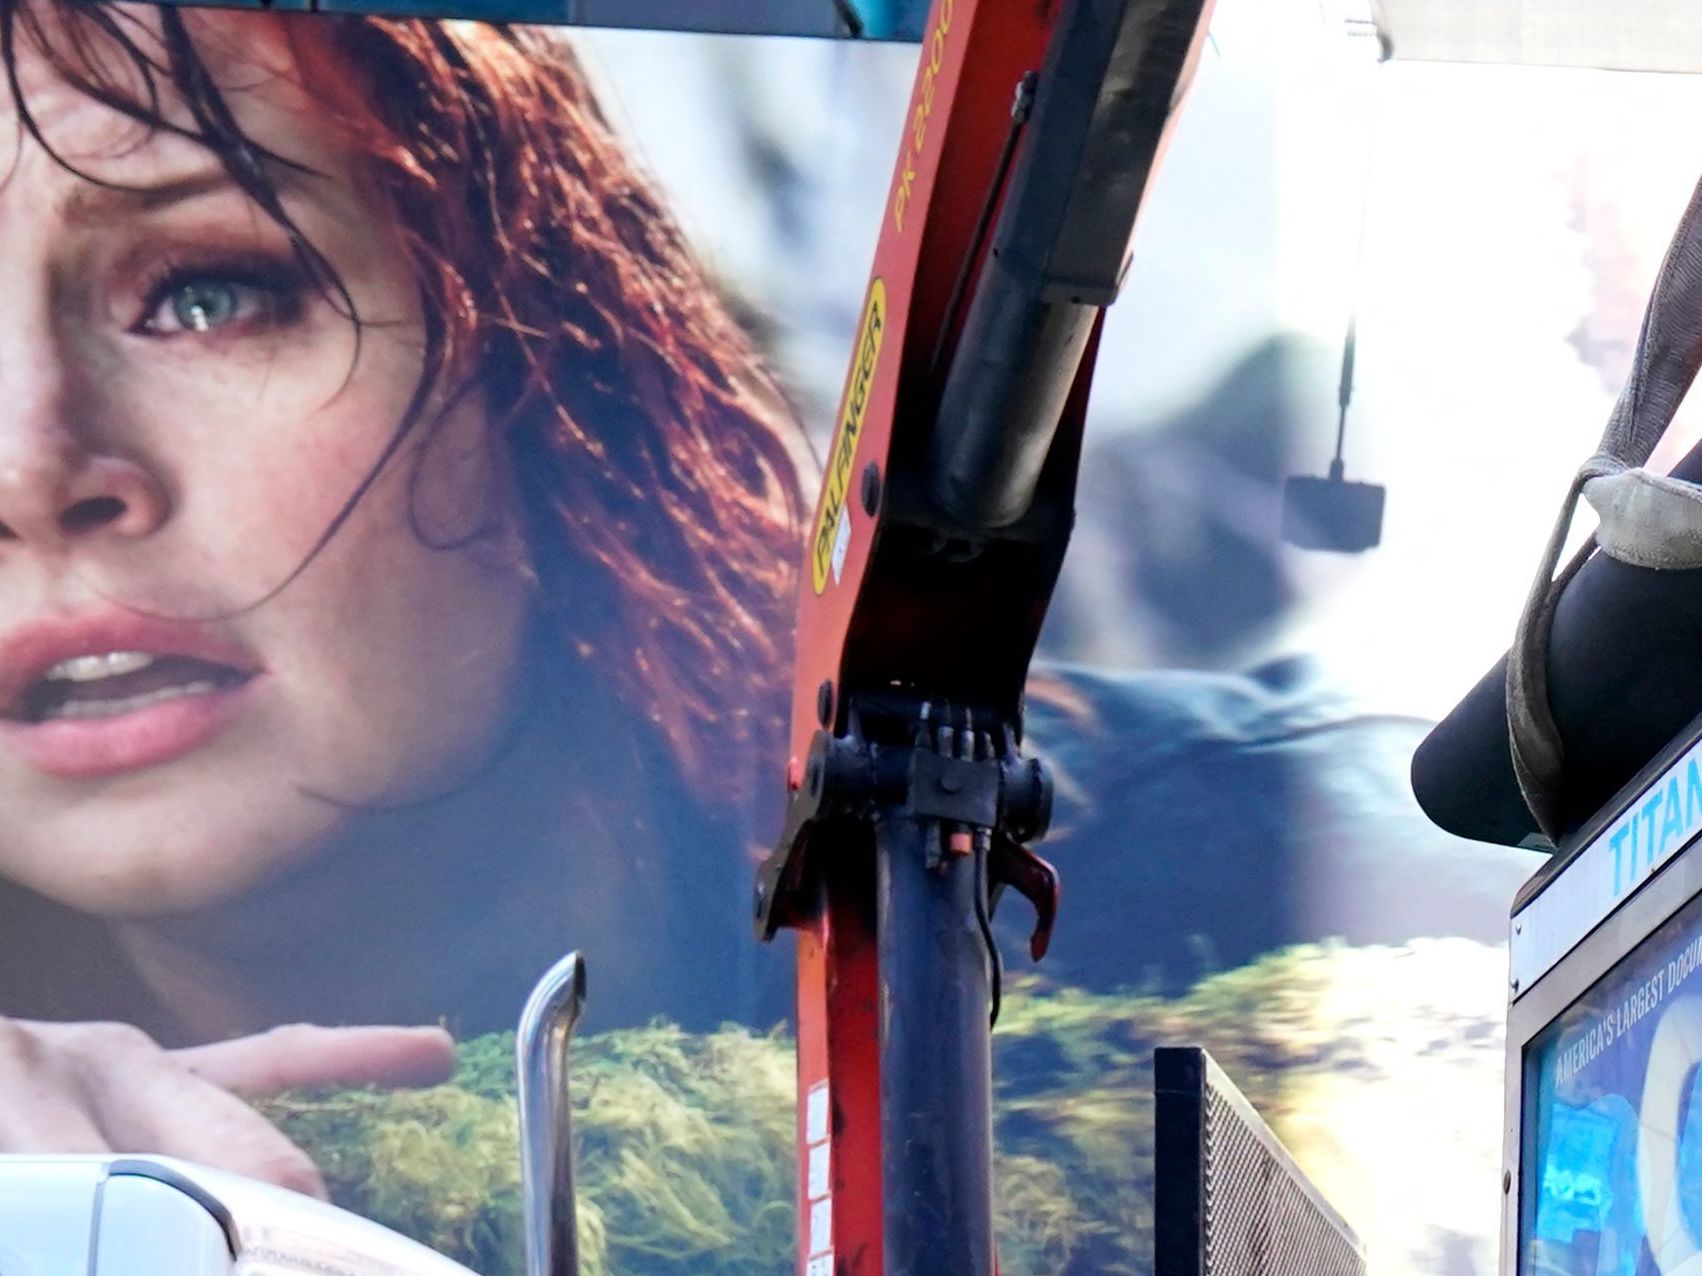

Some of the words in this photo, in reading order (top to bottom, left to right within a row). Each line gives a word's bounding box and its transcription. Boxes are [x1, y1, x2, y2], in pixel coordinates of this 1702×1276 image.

[815, 298, 883, 580] PALFINGER
[1555, 1013, 1614, 1089] AMERICA'S
[1616, 969, 1666, 1038] LARGEST
